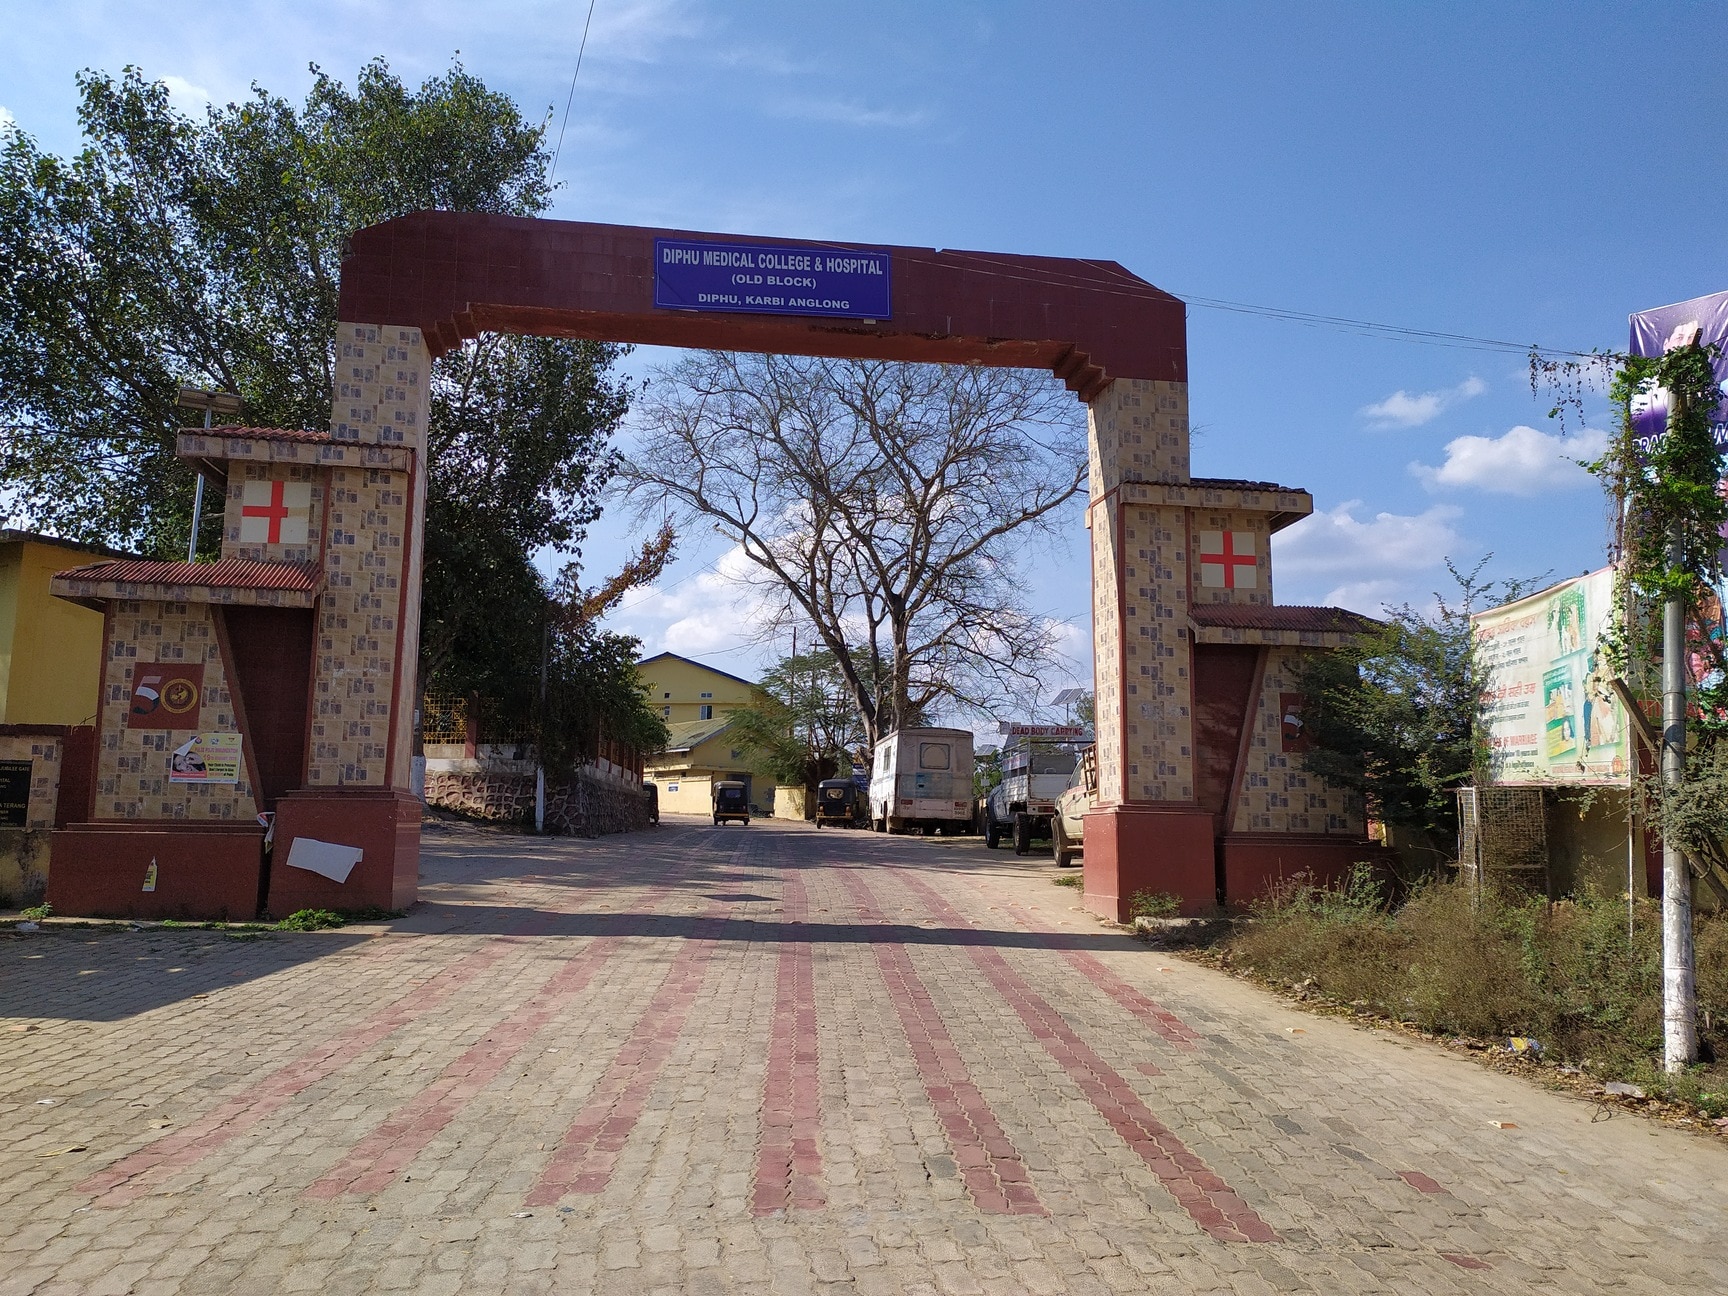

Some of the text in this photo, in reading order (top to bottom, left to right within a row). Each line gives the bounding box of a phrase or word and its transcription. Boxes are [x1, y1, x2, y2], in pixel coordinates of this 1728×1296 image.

[663, 248, 883, 275] DIPHU MEDICAL COLLEGE & HOSPITAL
[731, 273, 817, 289] (OLD BLOCK)
[698, 293, 850, 310] DIPHU, KARBI ANGLONG
[1012, 726, 1083, 736] DEAD BODY CARRYING
